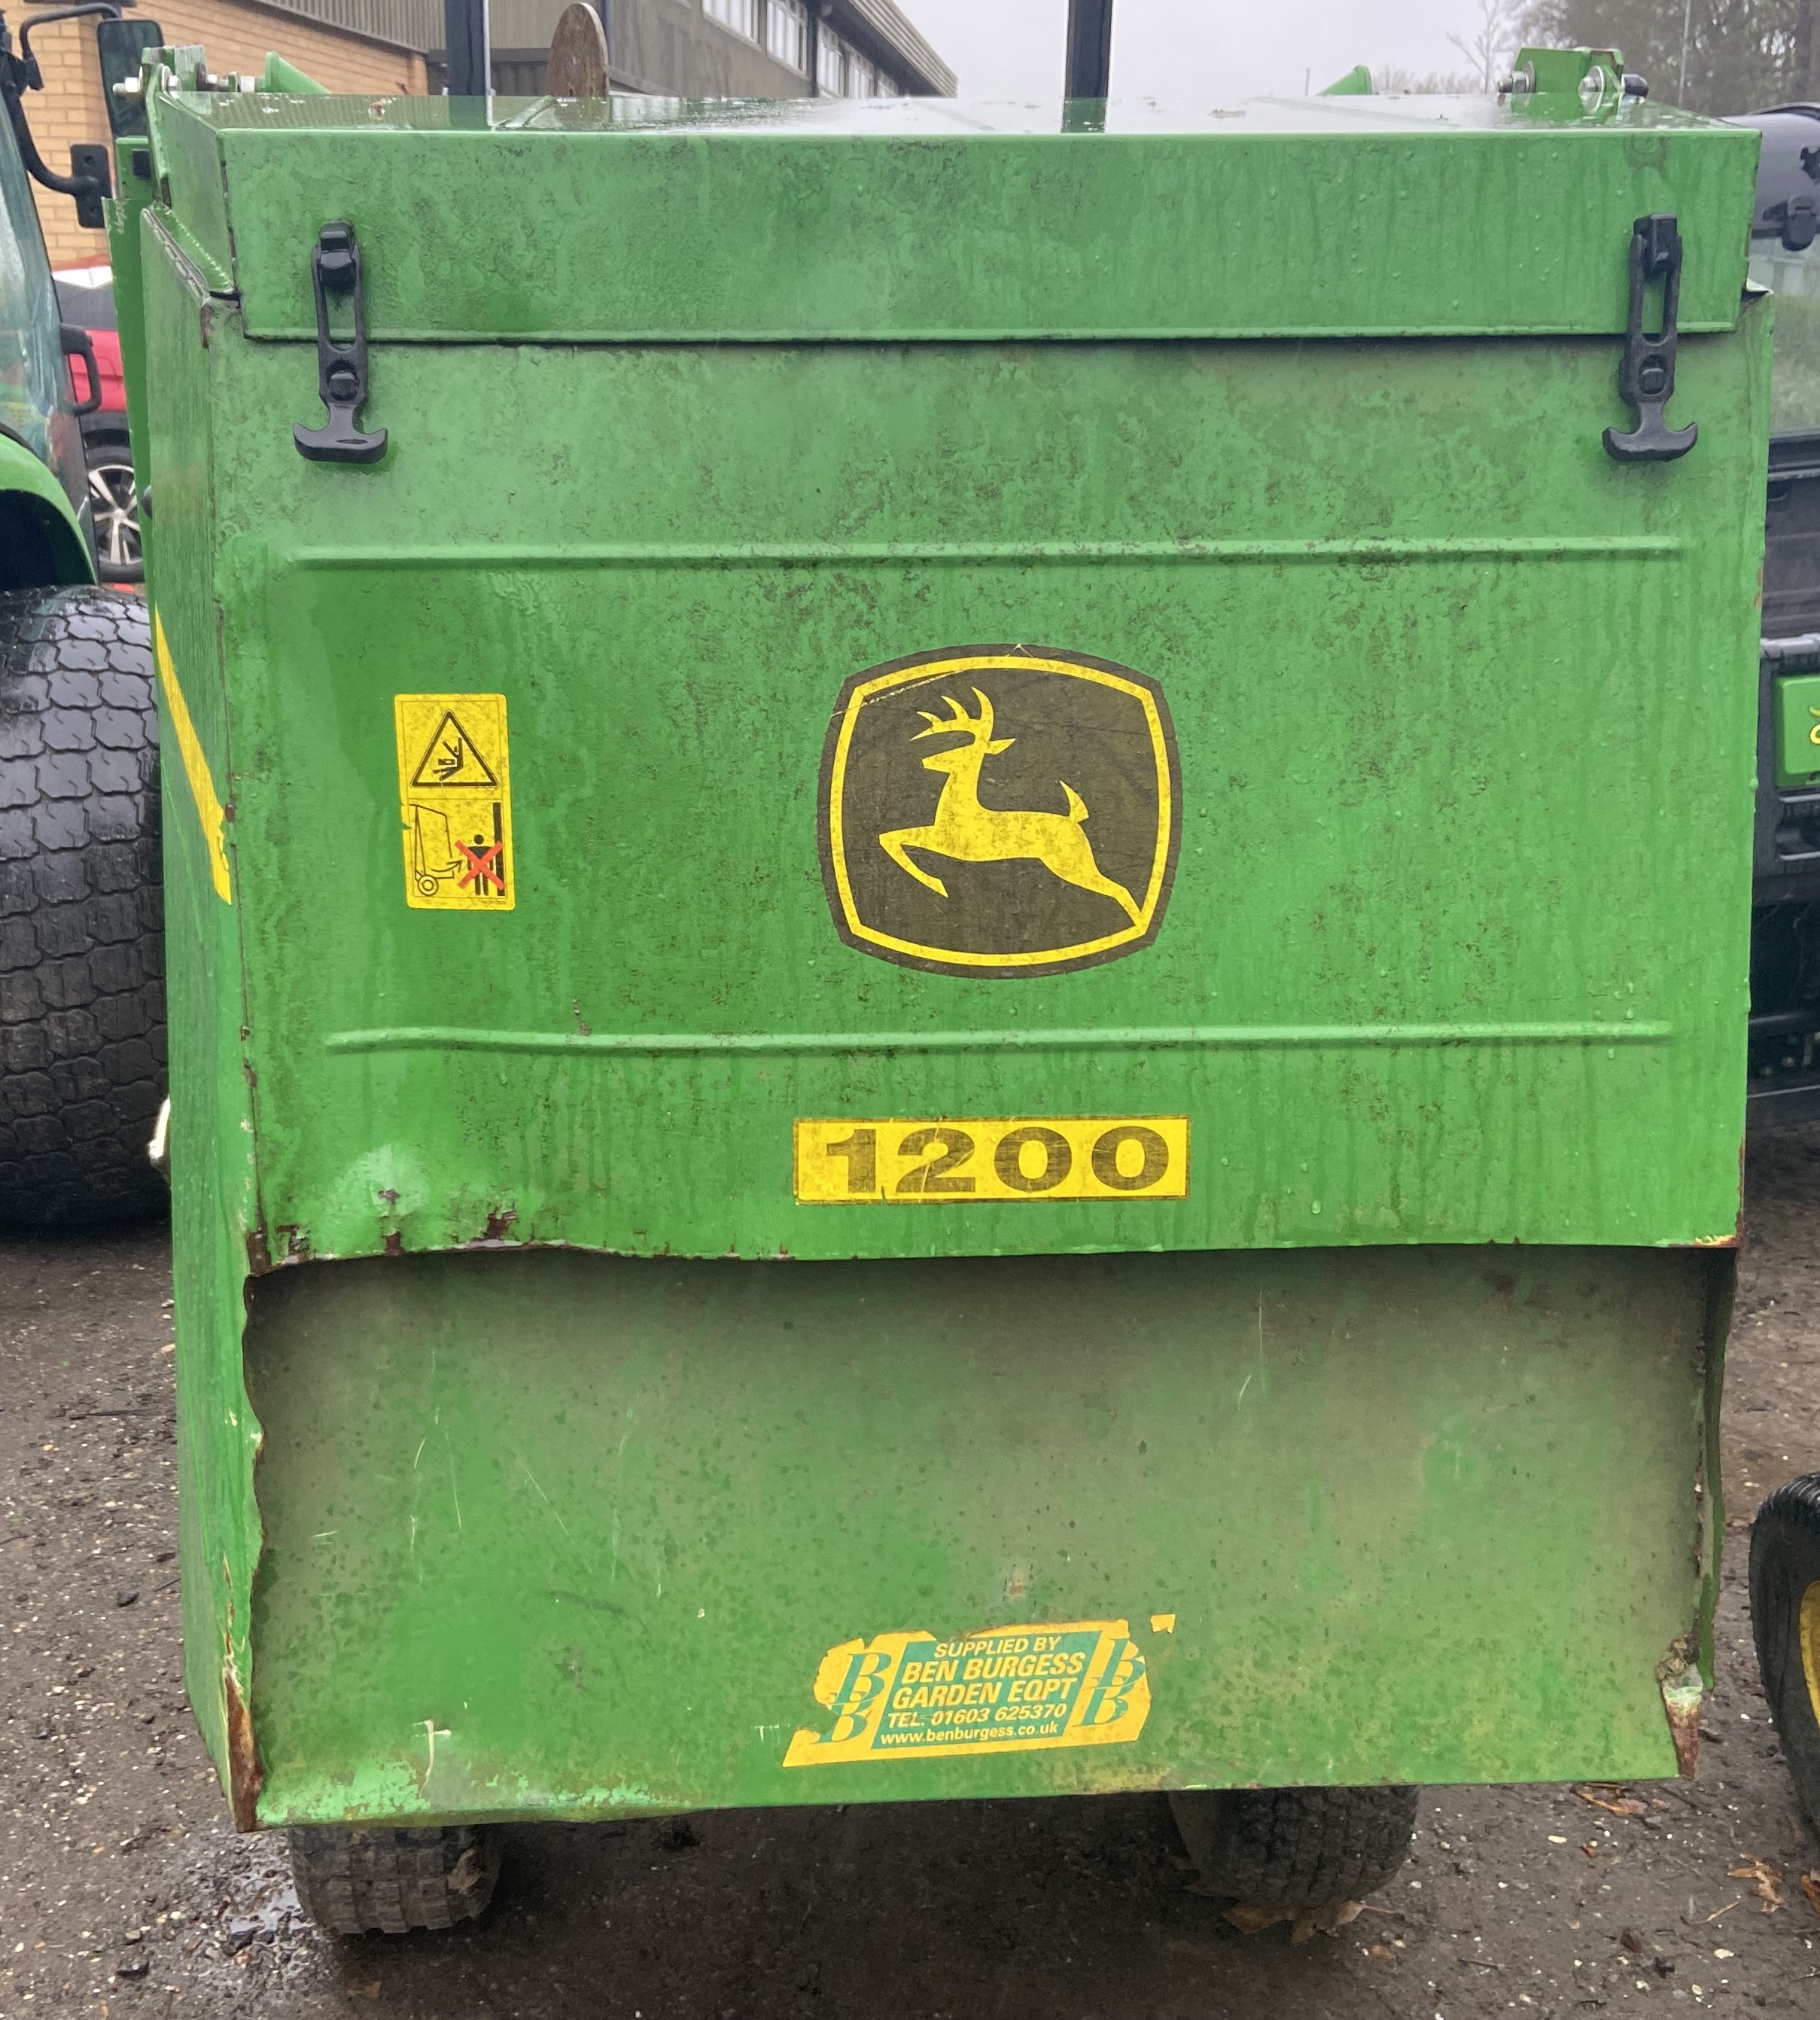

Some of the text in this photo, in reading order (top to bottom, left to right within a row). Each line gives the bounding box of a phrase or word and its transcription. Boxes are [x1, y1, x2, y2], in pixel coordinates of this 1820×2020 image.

[826, 1126, 1169, 1193] 1200
[934, 1636, 1062, 1658] SUPPLIED BY
[901, 1651, 1085, 1683] BEN BURGESS
[893, 1677, 1077, 1710] GARDEN EQPT
[888, 1704, 1067, 1728] TEL. 01603 625370
[881, 1721, 1058, 1744] www.benburgess.co.uk
